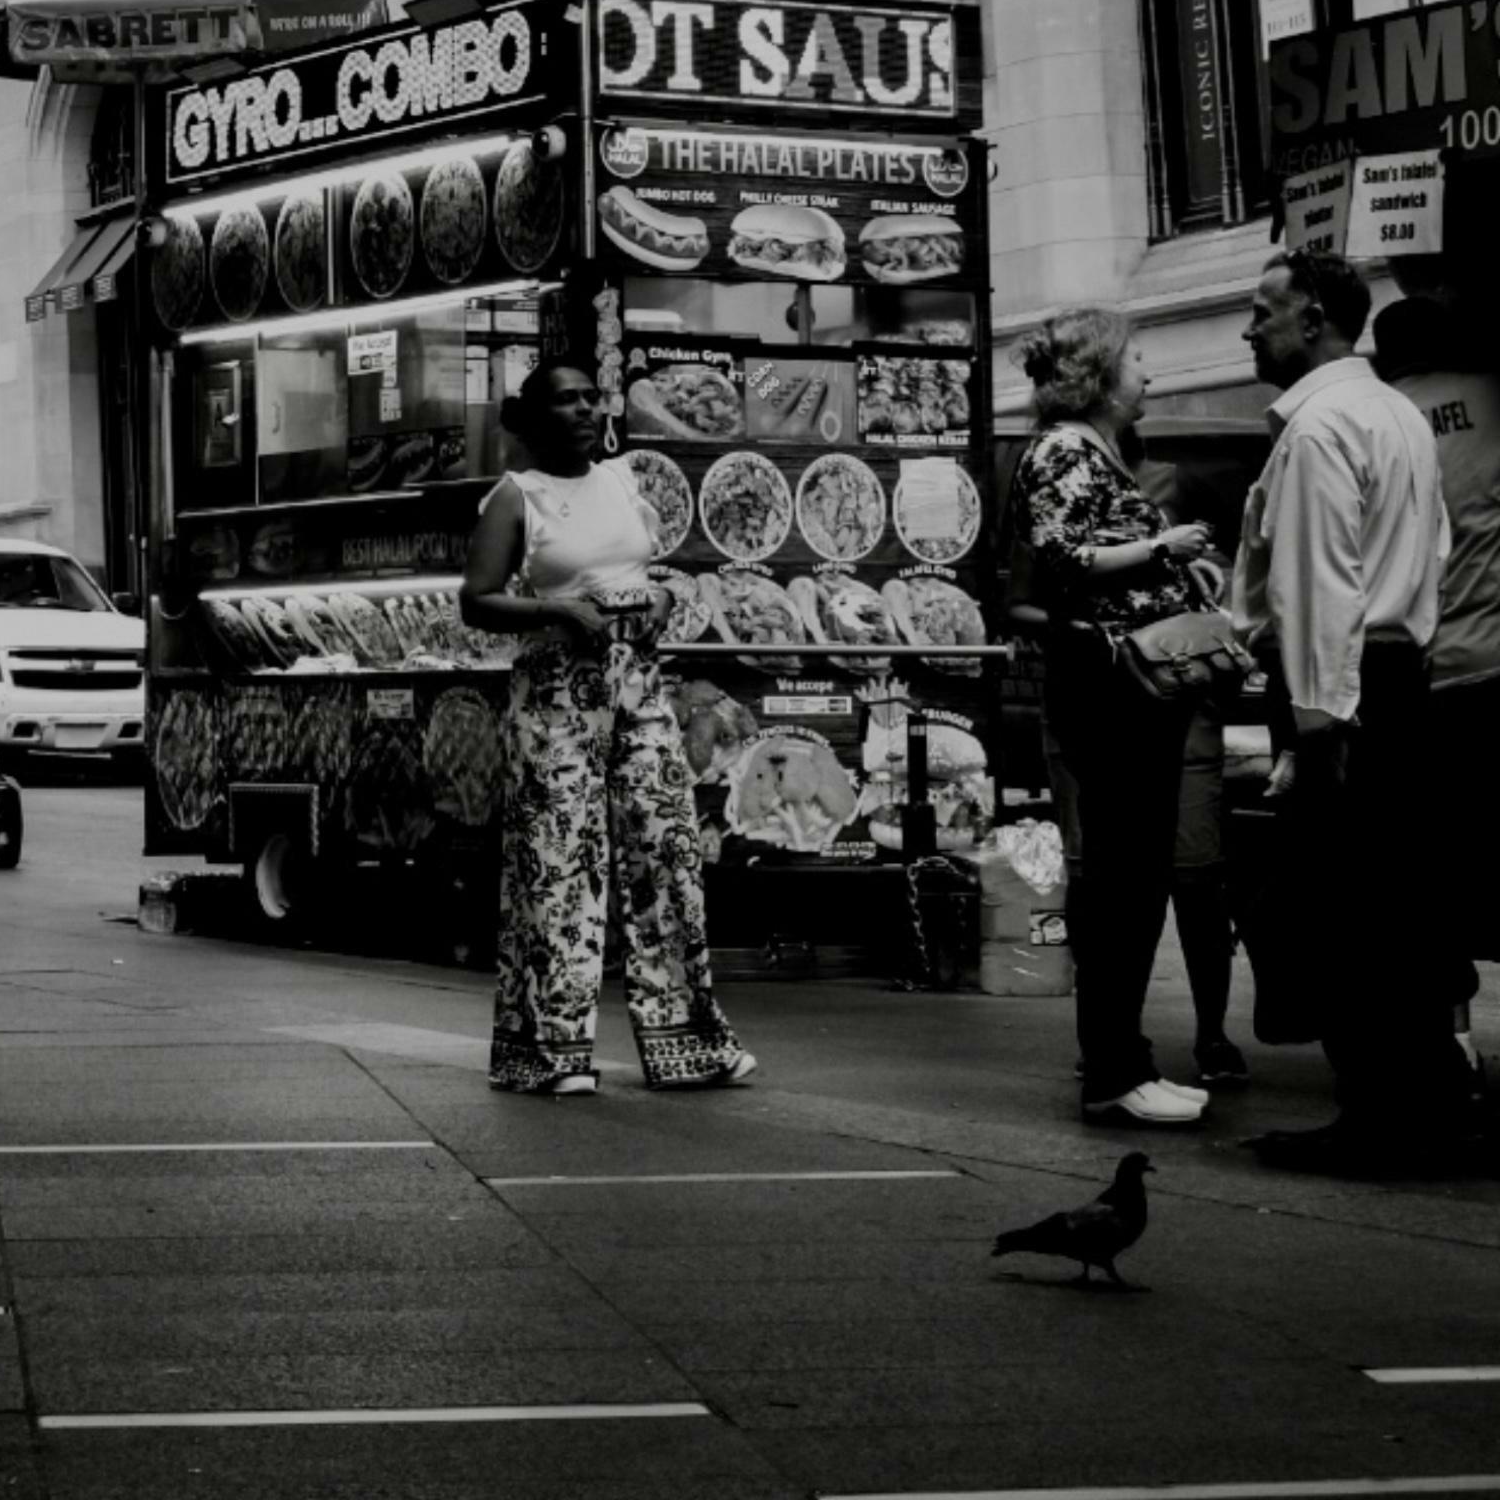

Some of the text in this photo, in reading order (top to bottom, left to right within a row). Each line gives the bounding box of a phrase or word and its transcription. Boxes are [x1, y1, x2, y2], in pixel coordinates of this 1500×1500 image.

[17, 7, 238, 51] SABRETT
[1194, 38, 1216, 141] ICONIC
[1270, 0, 1500, 134] SAM'
[657, 136, 712, 172] THE
[720, 140, 810, 179] HALAL
[817, 146, 916, 184] PLATES
[648, 346, 700, 361] Chicken
